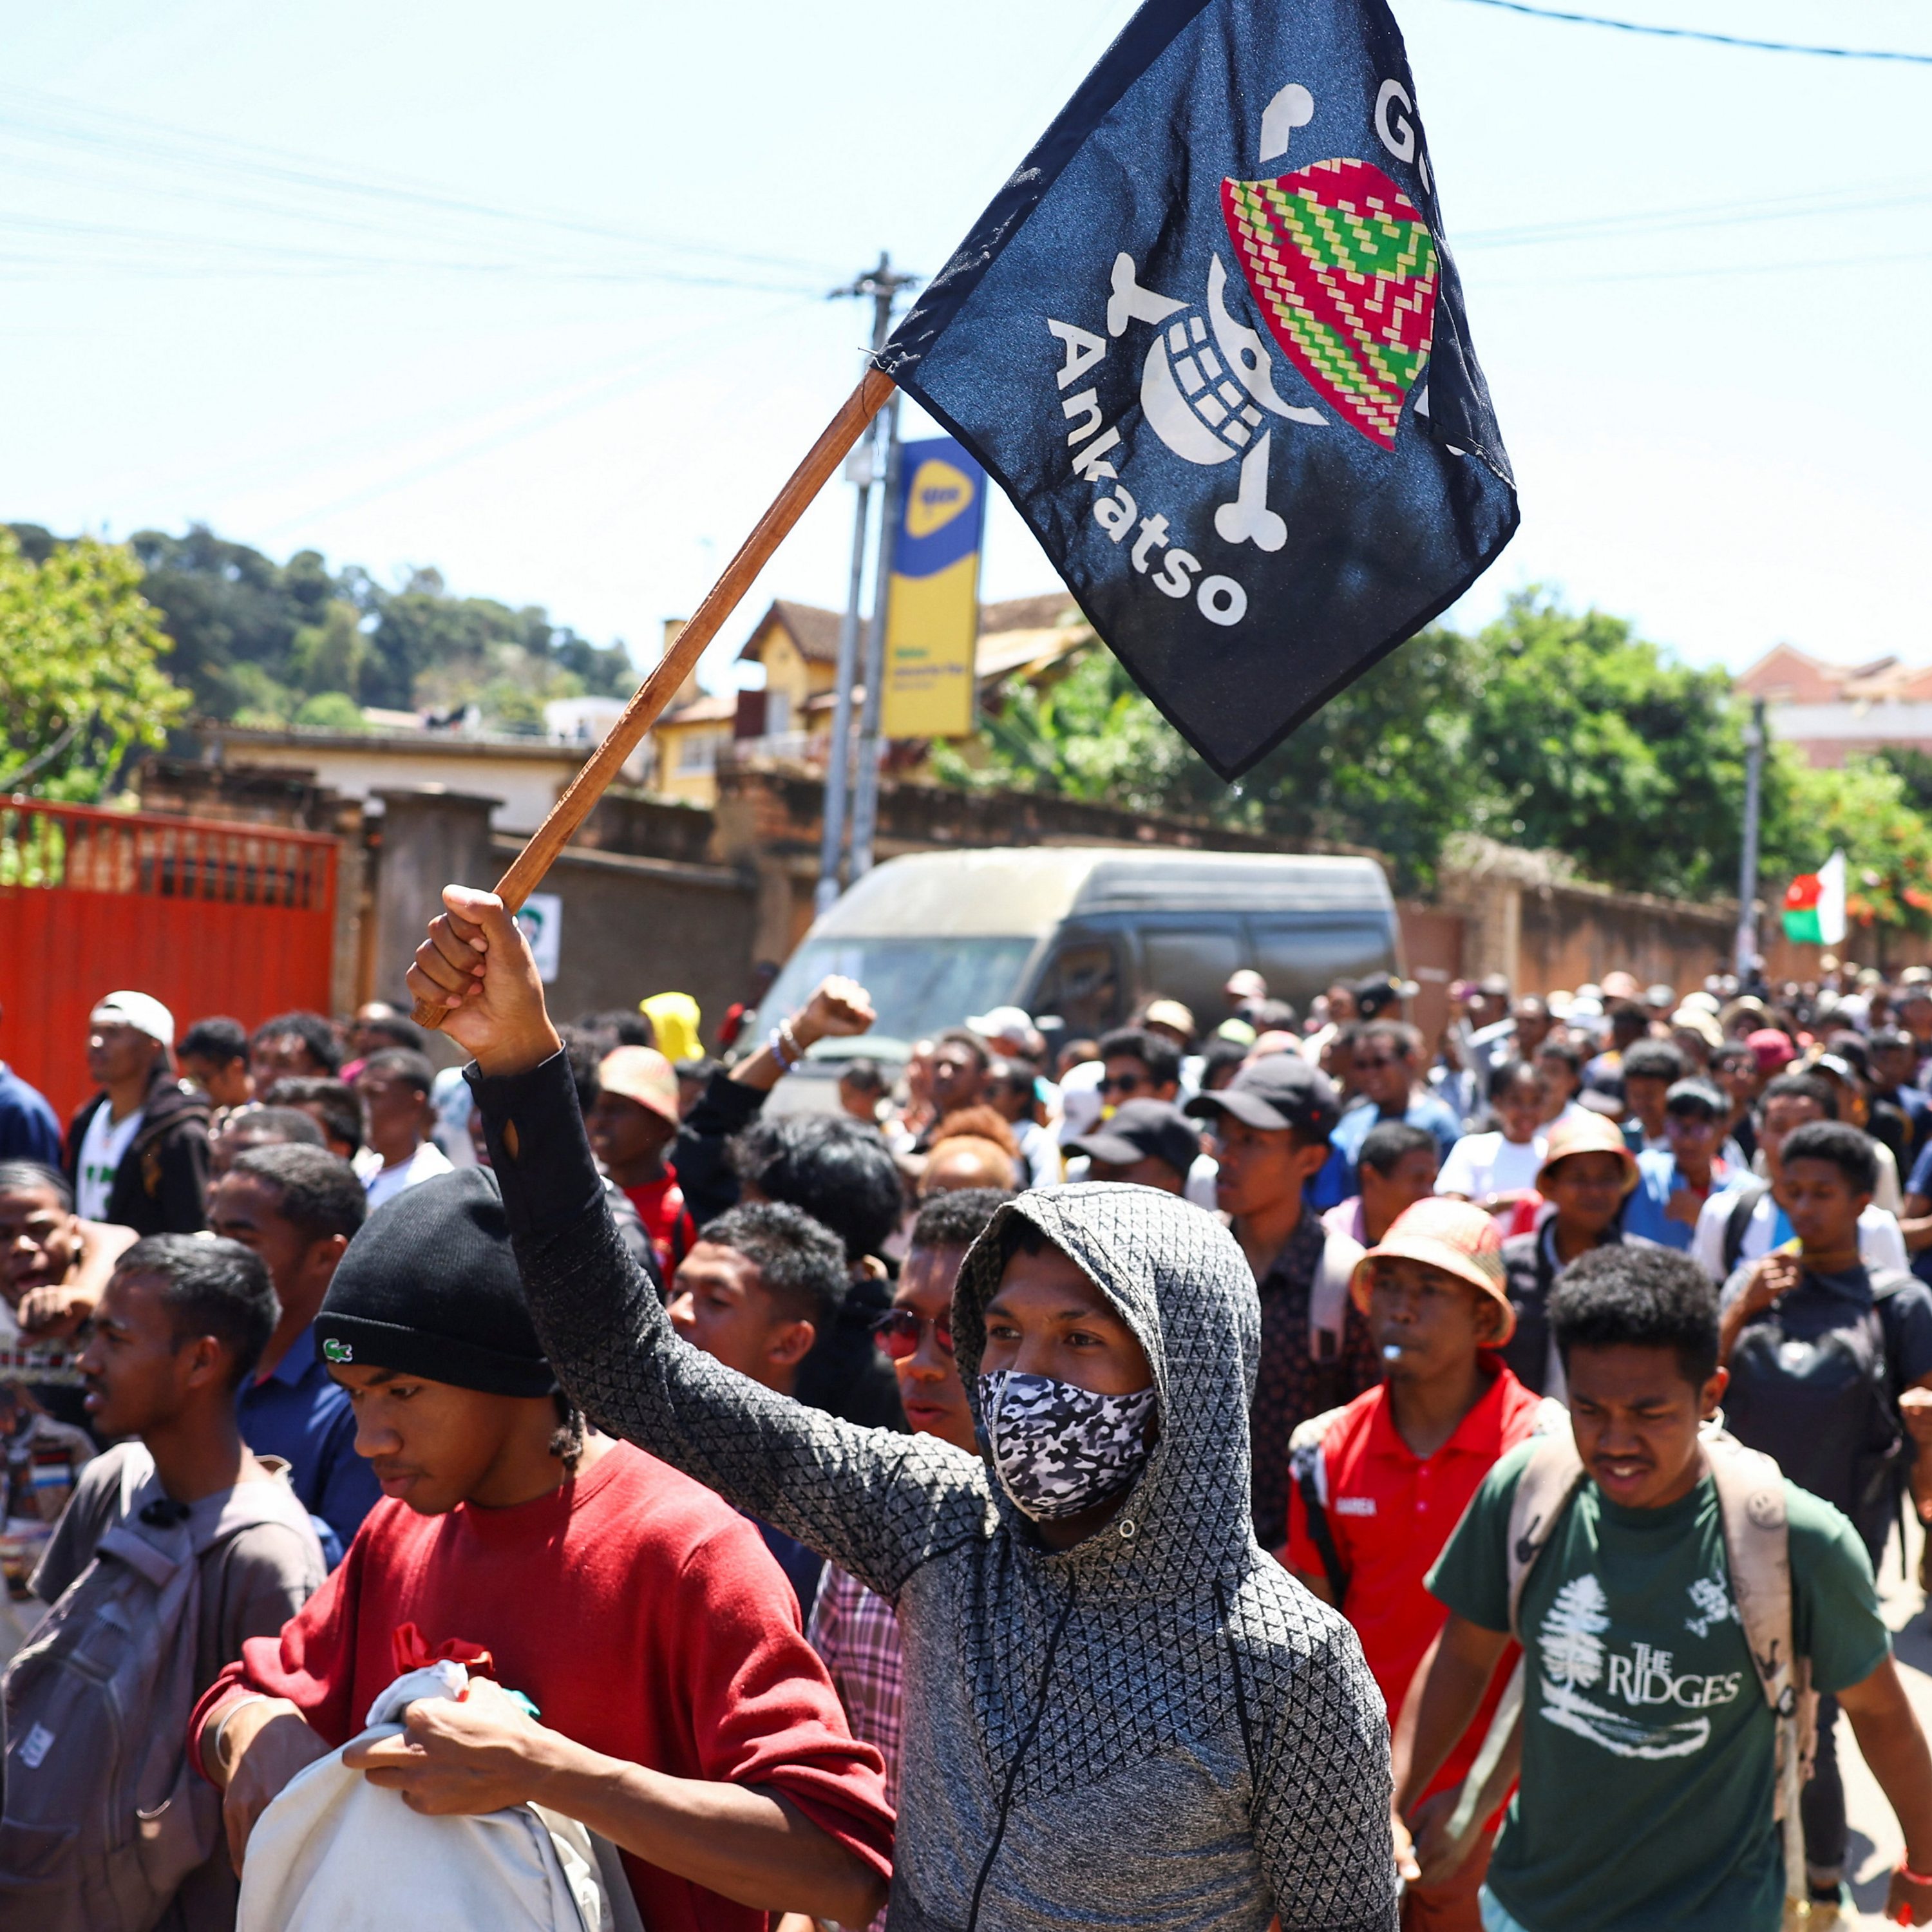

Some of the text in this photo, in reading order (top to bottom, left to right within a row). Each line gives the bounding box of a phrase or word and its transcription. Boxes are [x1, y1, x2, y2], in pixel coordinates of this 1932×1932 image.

[1047, 318, 1248, 627] Ankatso
[1607, 1653, 1743, 1707] RIDGES
[1631, 1641, 1674, 1673] THE
